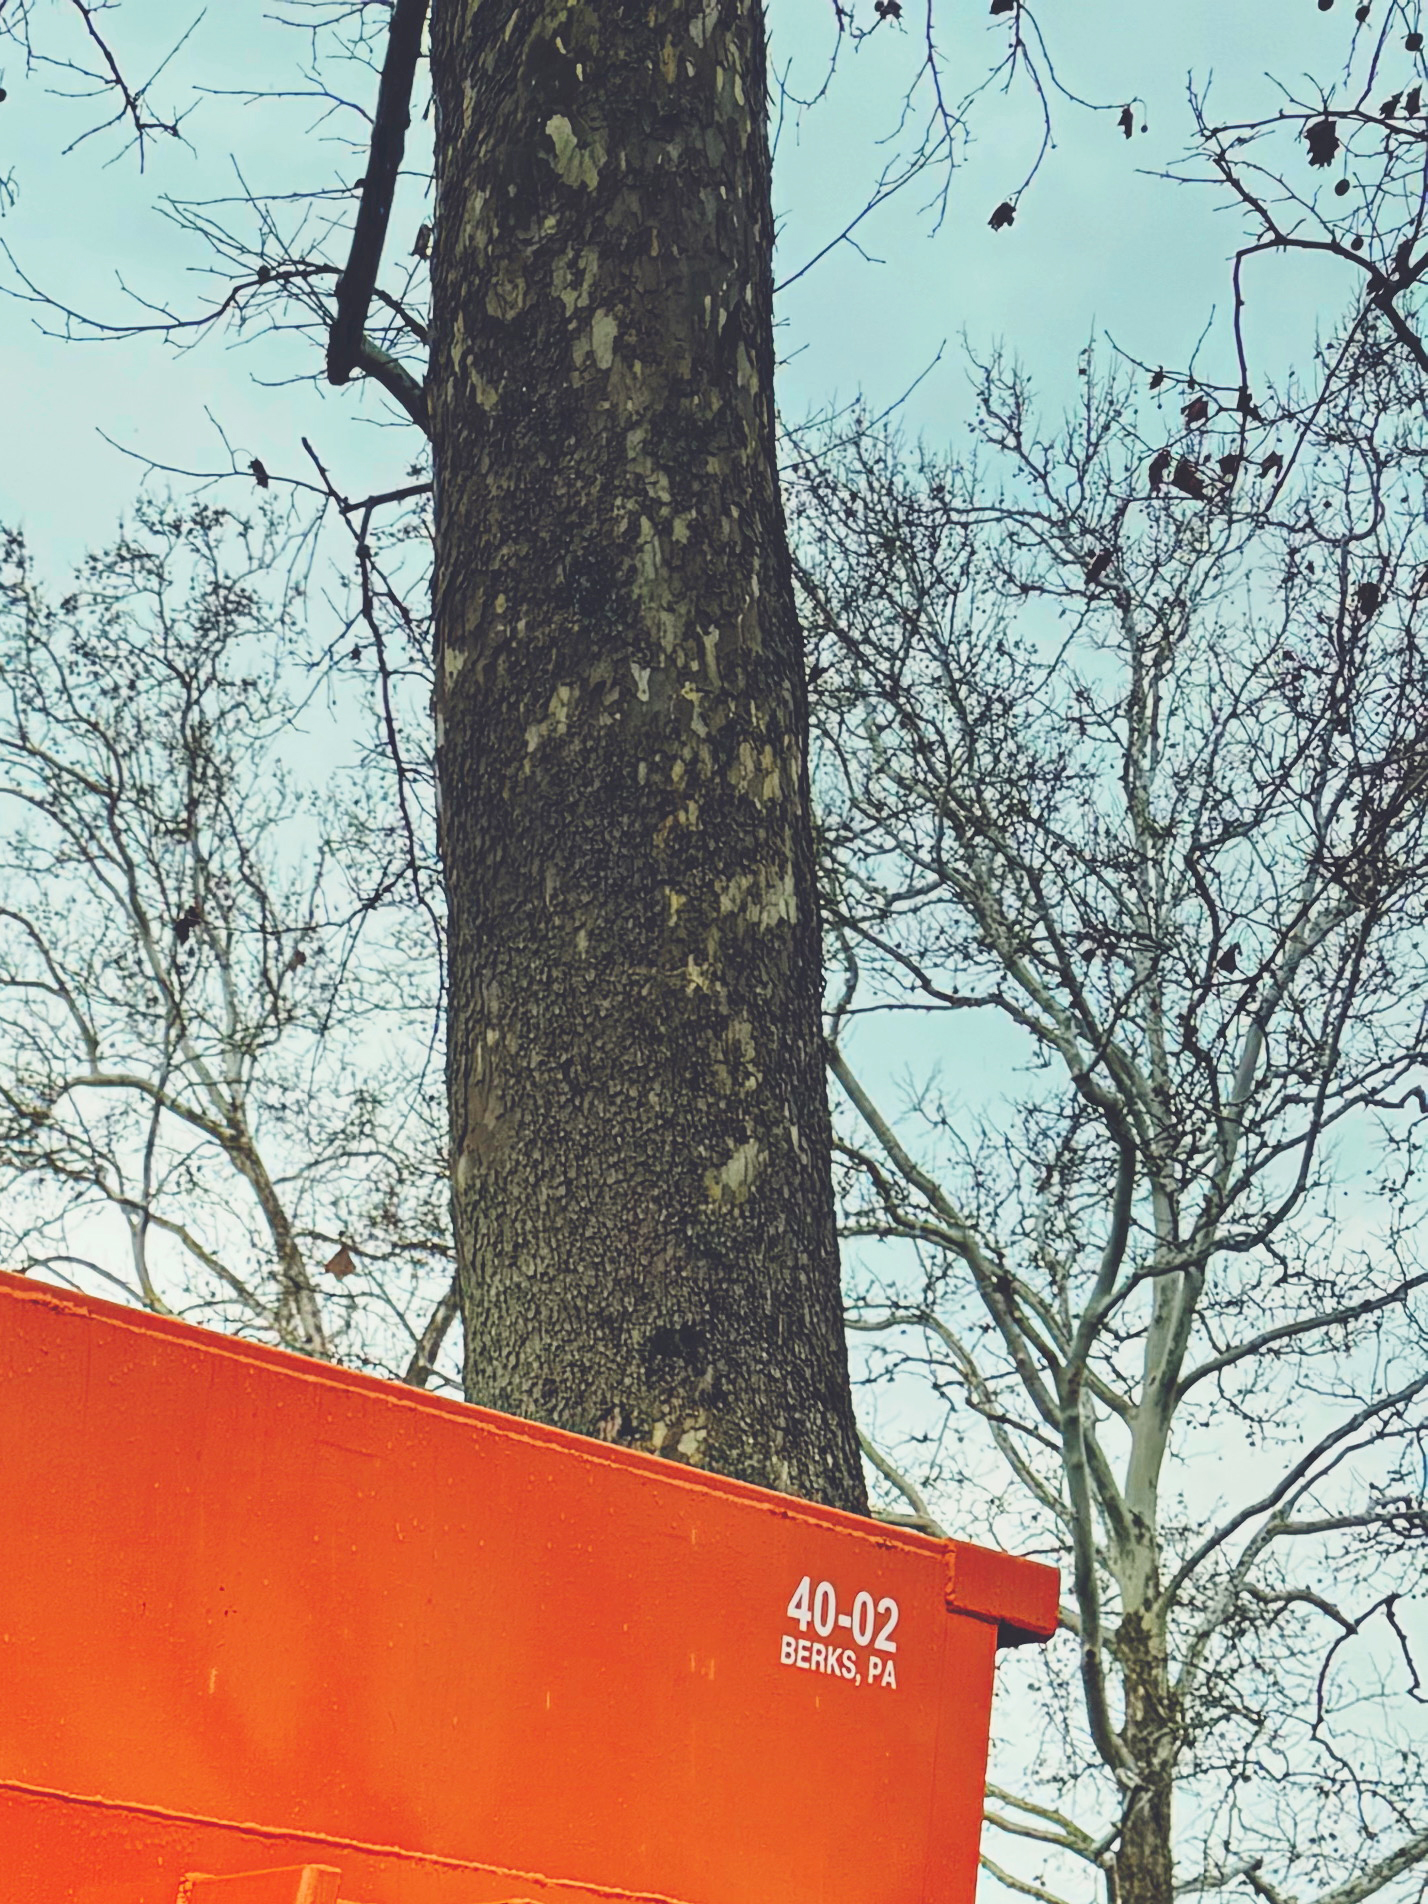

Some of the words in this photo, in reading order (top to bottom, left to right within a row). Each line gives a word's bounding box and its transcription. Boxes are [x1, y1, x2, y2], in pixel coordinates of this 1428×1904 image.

[786, 1575, 900, 1653] 40-02
[780, 1634, 862, 1687] BERKS,
[867, 1655, 897, 1690] PA
